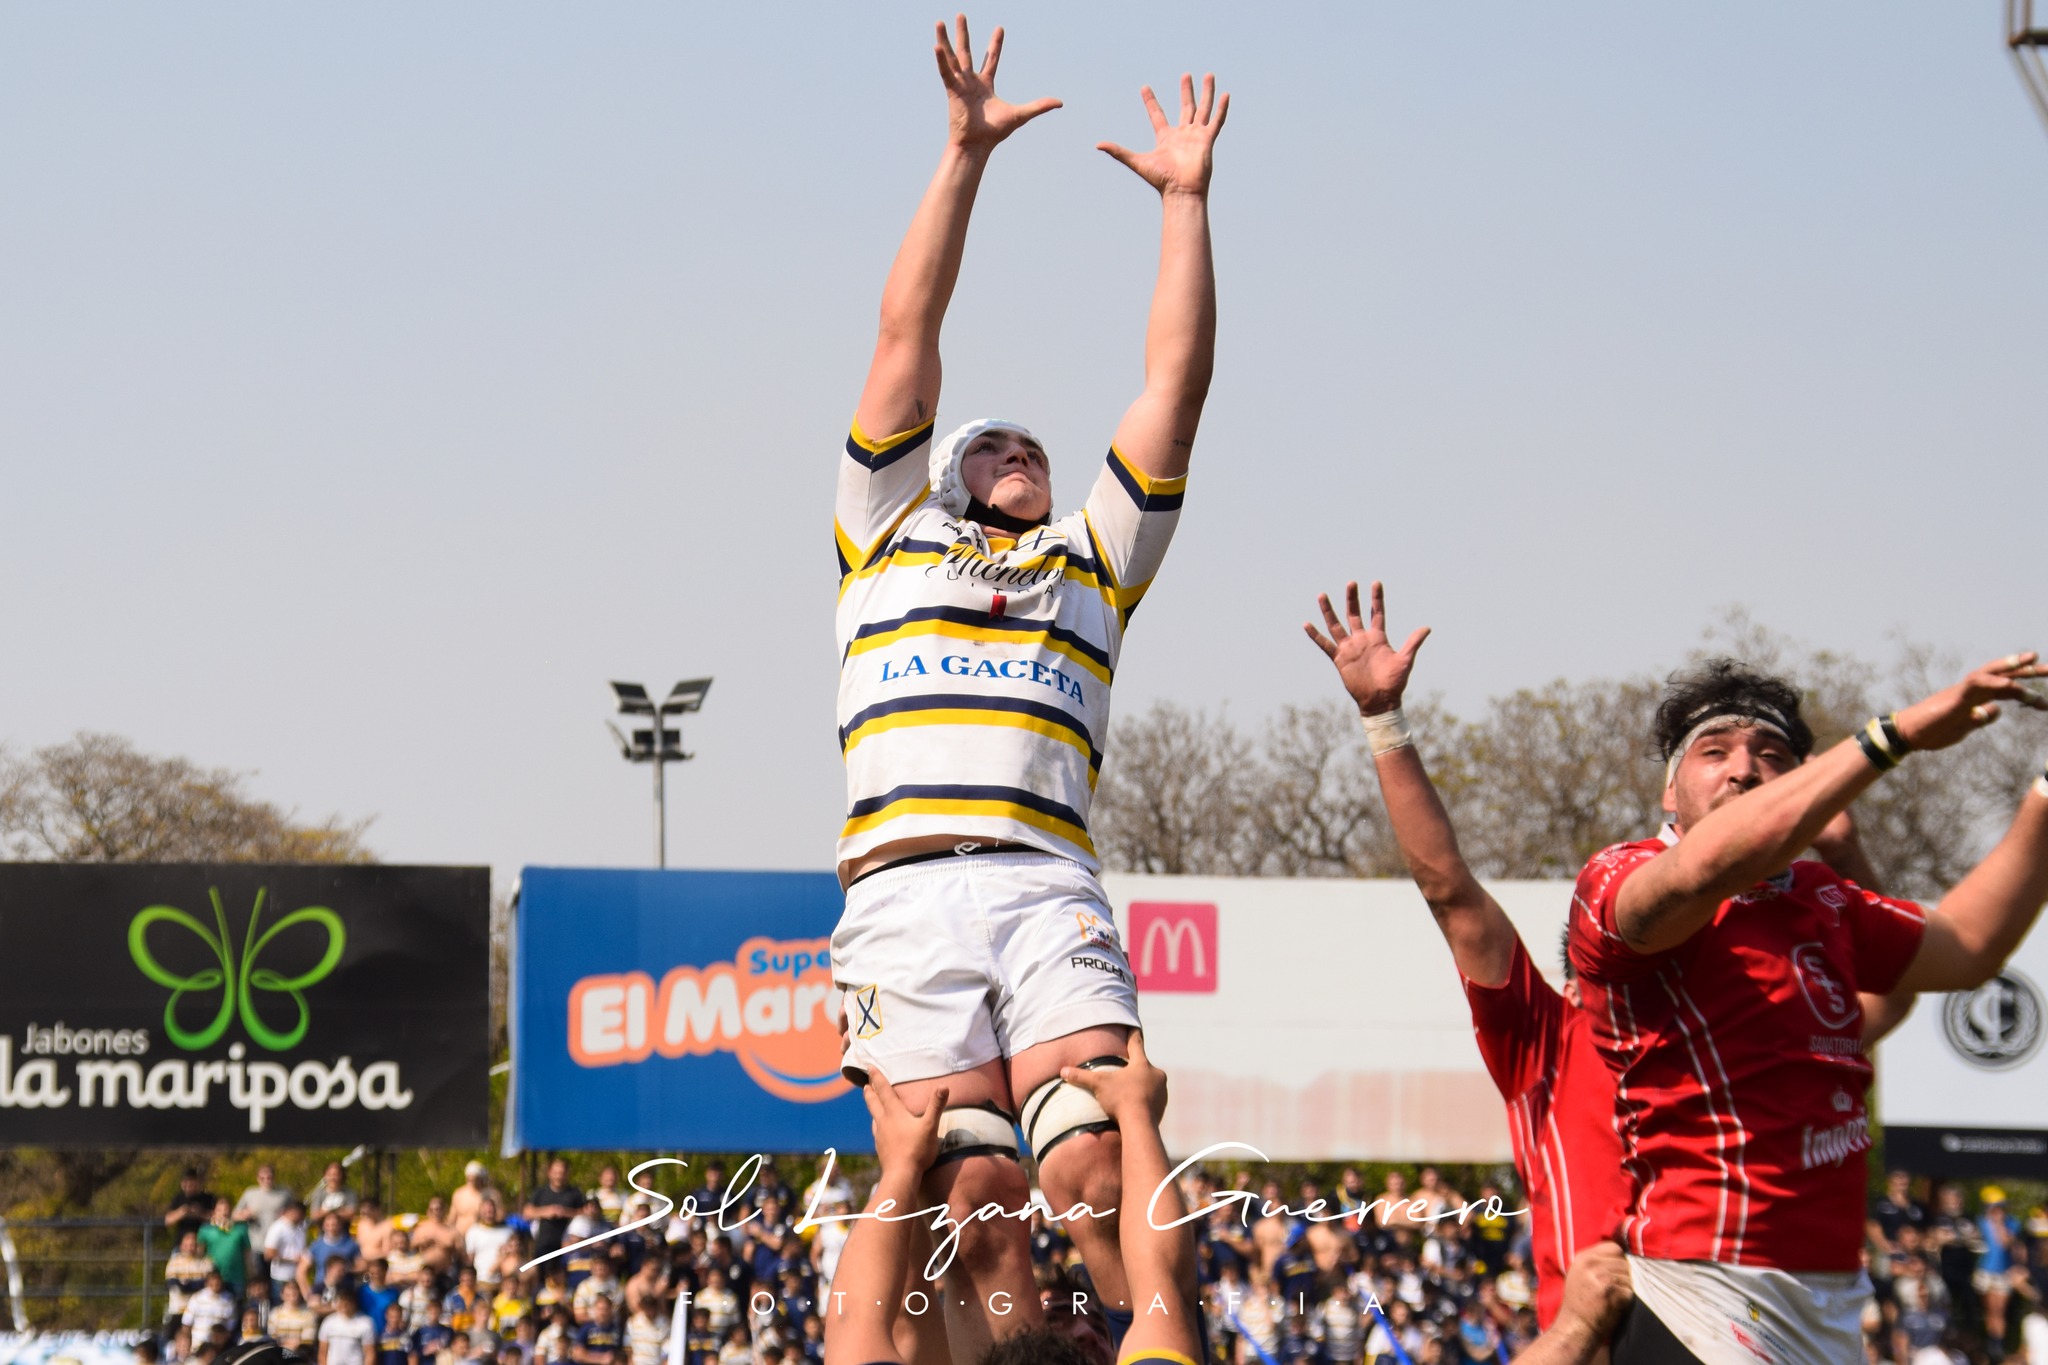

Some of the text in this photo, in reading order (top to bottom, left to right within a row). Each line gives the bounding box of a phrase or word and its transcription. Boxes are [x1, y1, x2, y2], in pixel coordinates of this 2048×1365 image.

[879, 655, 1085, 708] LA GACETA
[750, 949, 833, 980] Supe
[20, 1020, 150, 1055] Jabones
[581, 982, 647, 1056] El
[0, 1034, 414, 1133] la mariposa
